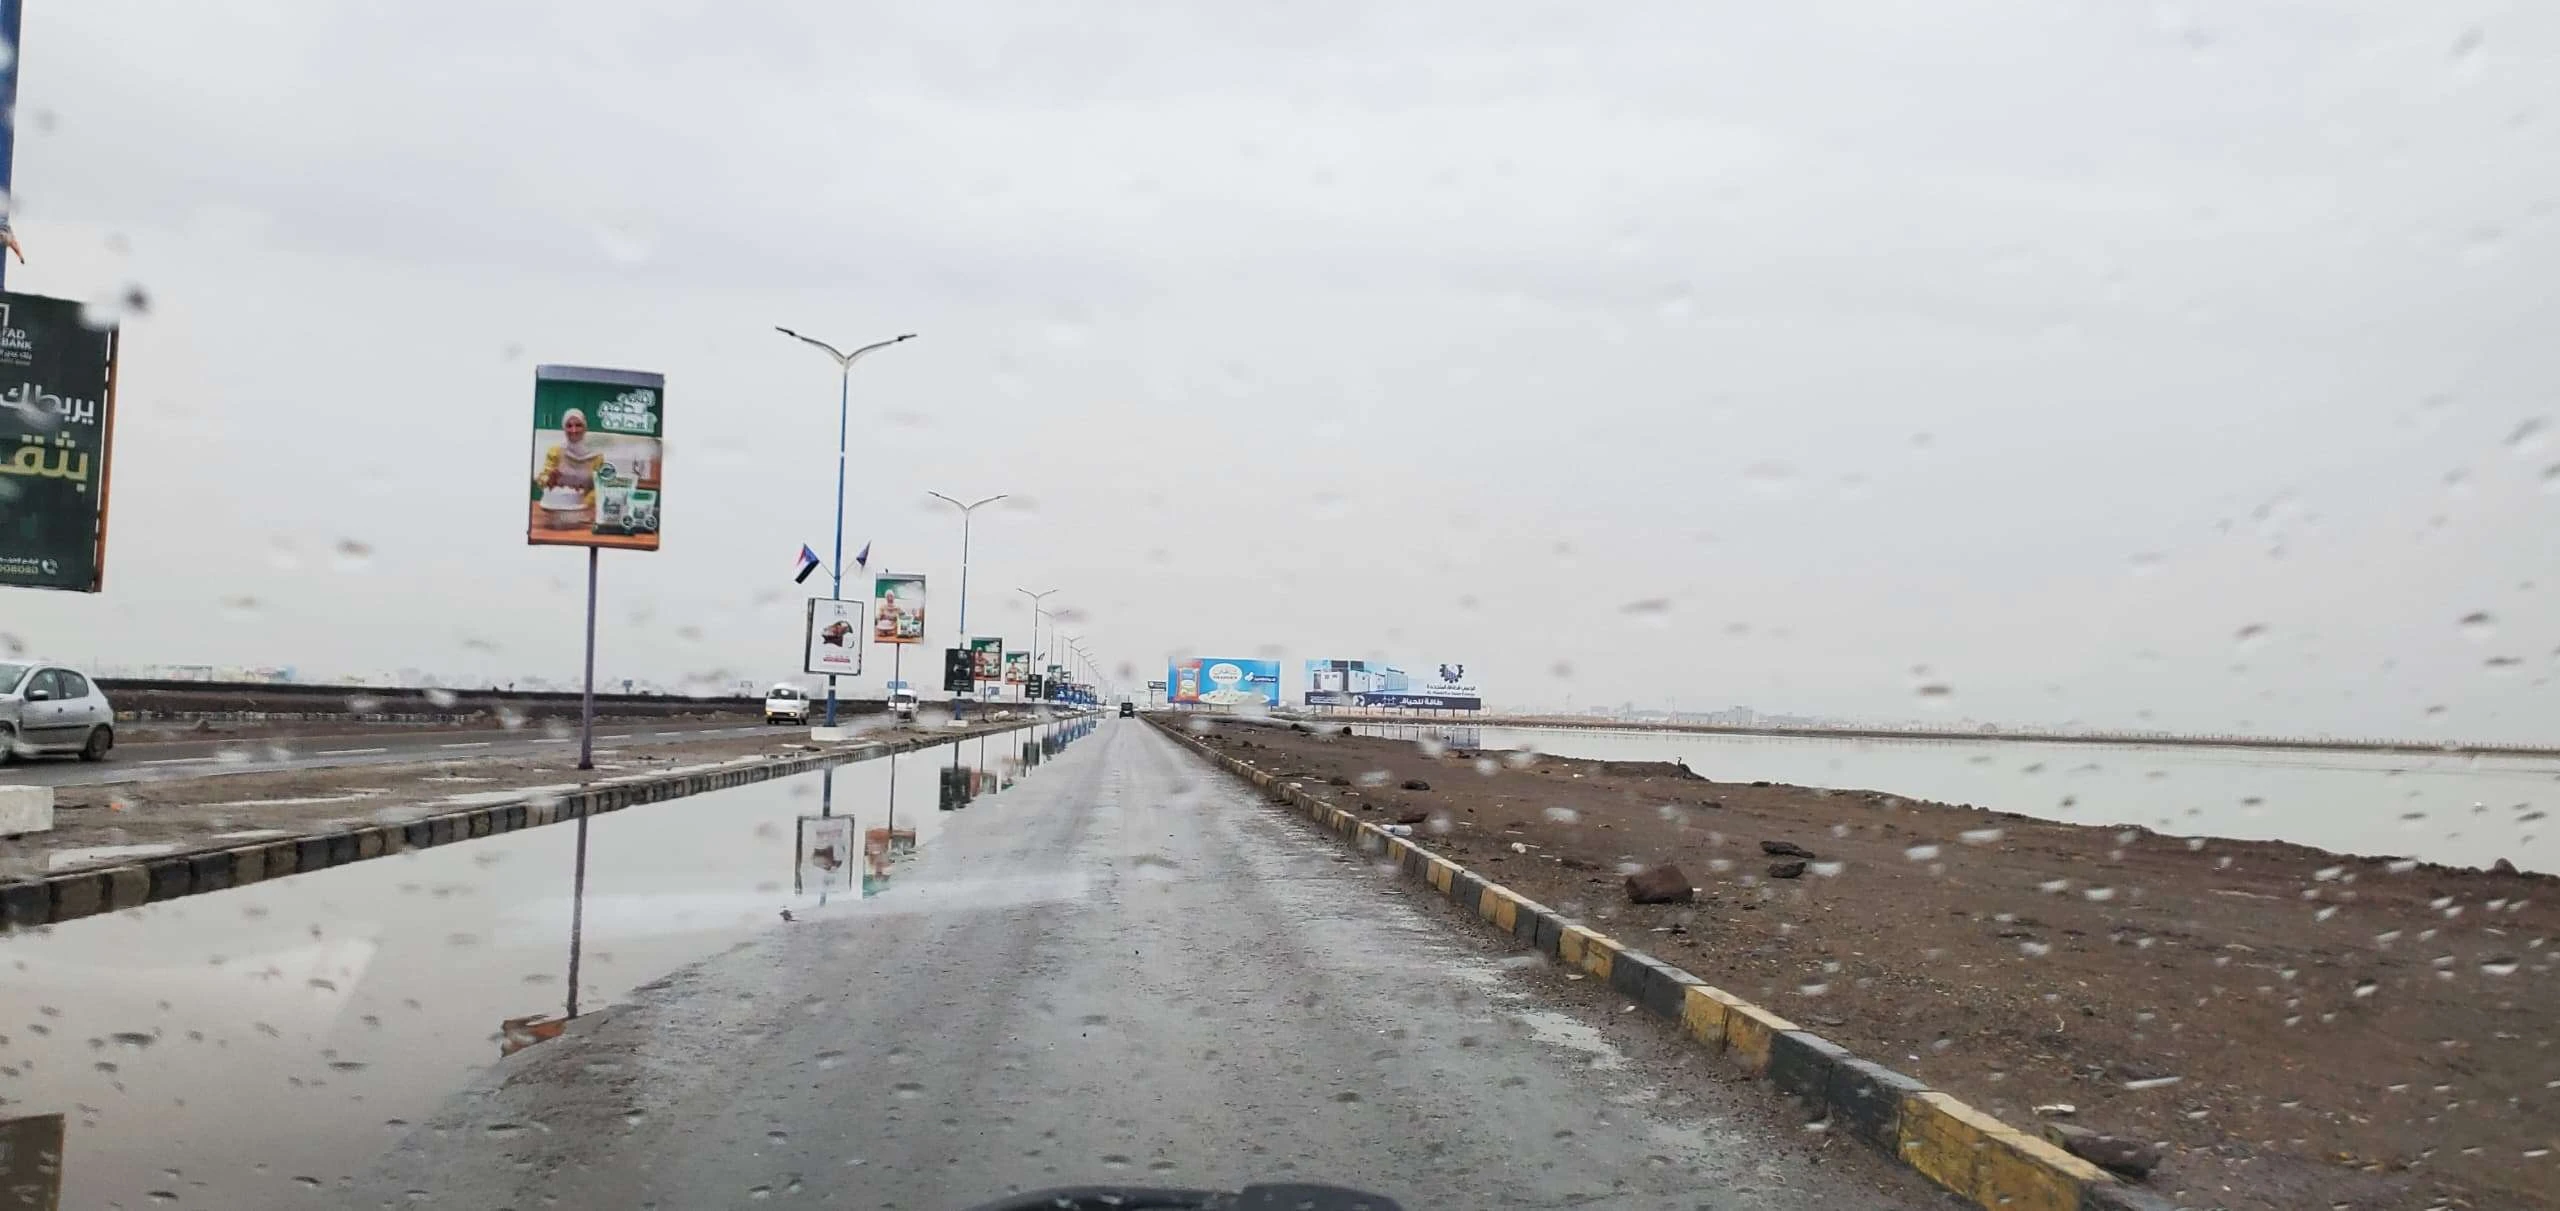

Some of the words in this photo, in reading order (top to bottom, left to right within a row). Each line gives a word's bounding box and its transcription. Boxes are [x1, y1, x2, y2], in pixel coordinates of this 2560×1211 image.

[1, 337, 32, 350] BANK
[0, 382, 94, 425] يربطك
[0, 431, 88, 493] بثق
